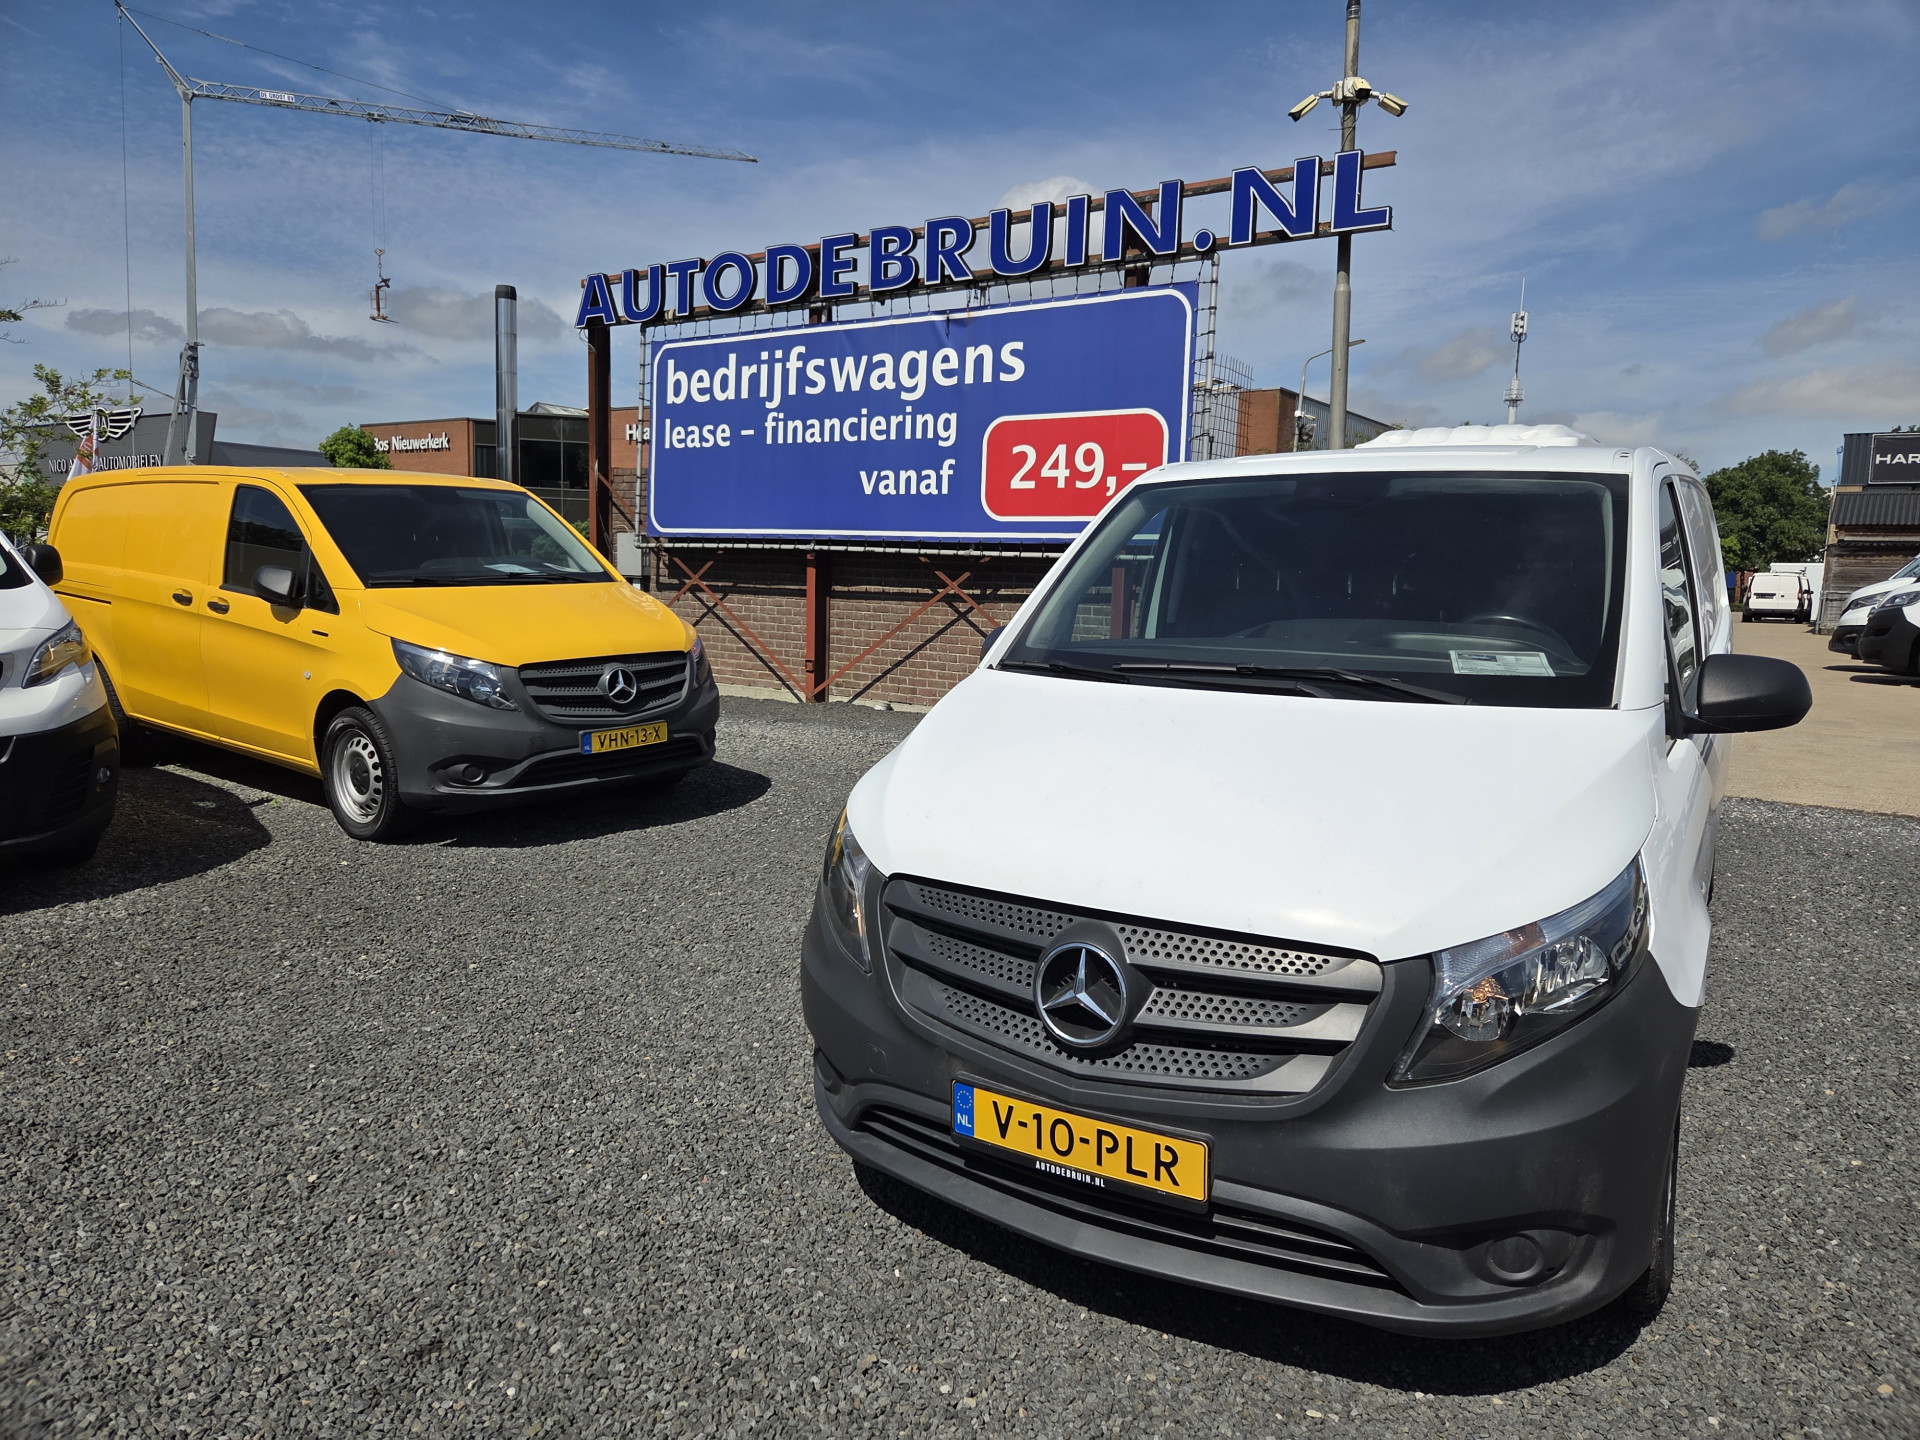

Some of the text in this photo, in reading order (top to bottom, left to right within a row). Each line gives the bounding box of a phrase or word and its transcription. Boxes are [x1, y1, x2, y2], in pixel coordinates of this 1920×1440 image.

[576, 150, 1392, 327] AUTODEBRUIN.NL
[666, 341, 1026, 409] bedrijfswagens
[391, 432, 449, 451] Nieuwerkerk
[664, 417, 731, 449] lease
[765, 406, 957, 448] financiering
[49, 459, 67, 472] NICO
[99, 454, 161, 470] AUTOMOBIELEN
[860, 459, 957, 496] vanaf
[598, 726, 661, 749] VHN-13-X
[957, 1112, 972, 1128] NL
[992, 1100, 1180, 1187] V-10-PLR
[1035, 1160, 1106, 1188] AUTODEBRUIN.NL
